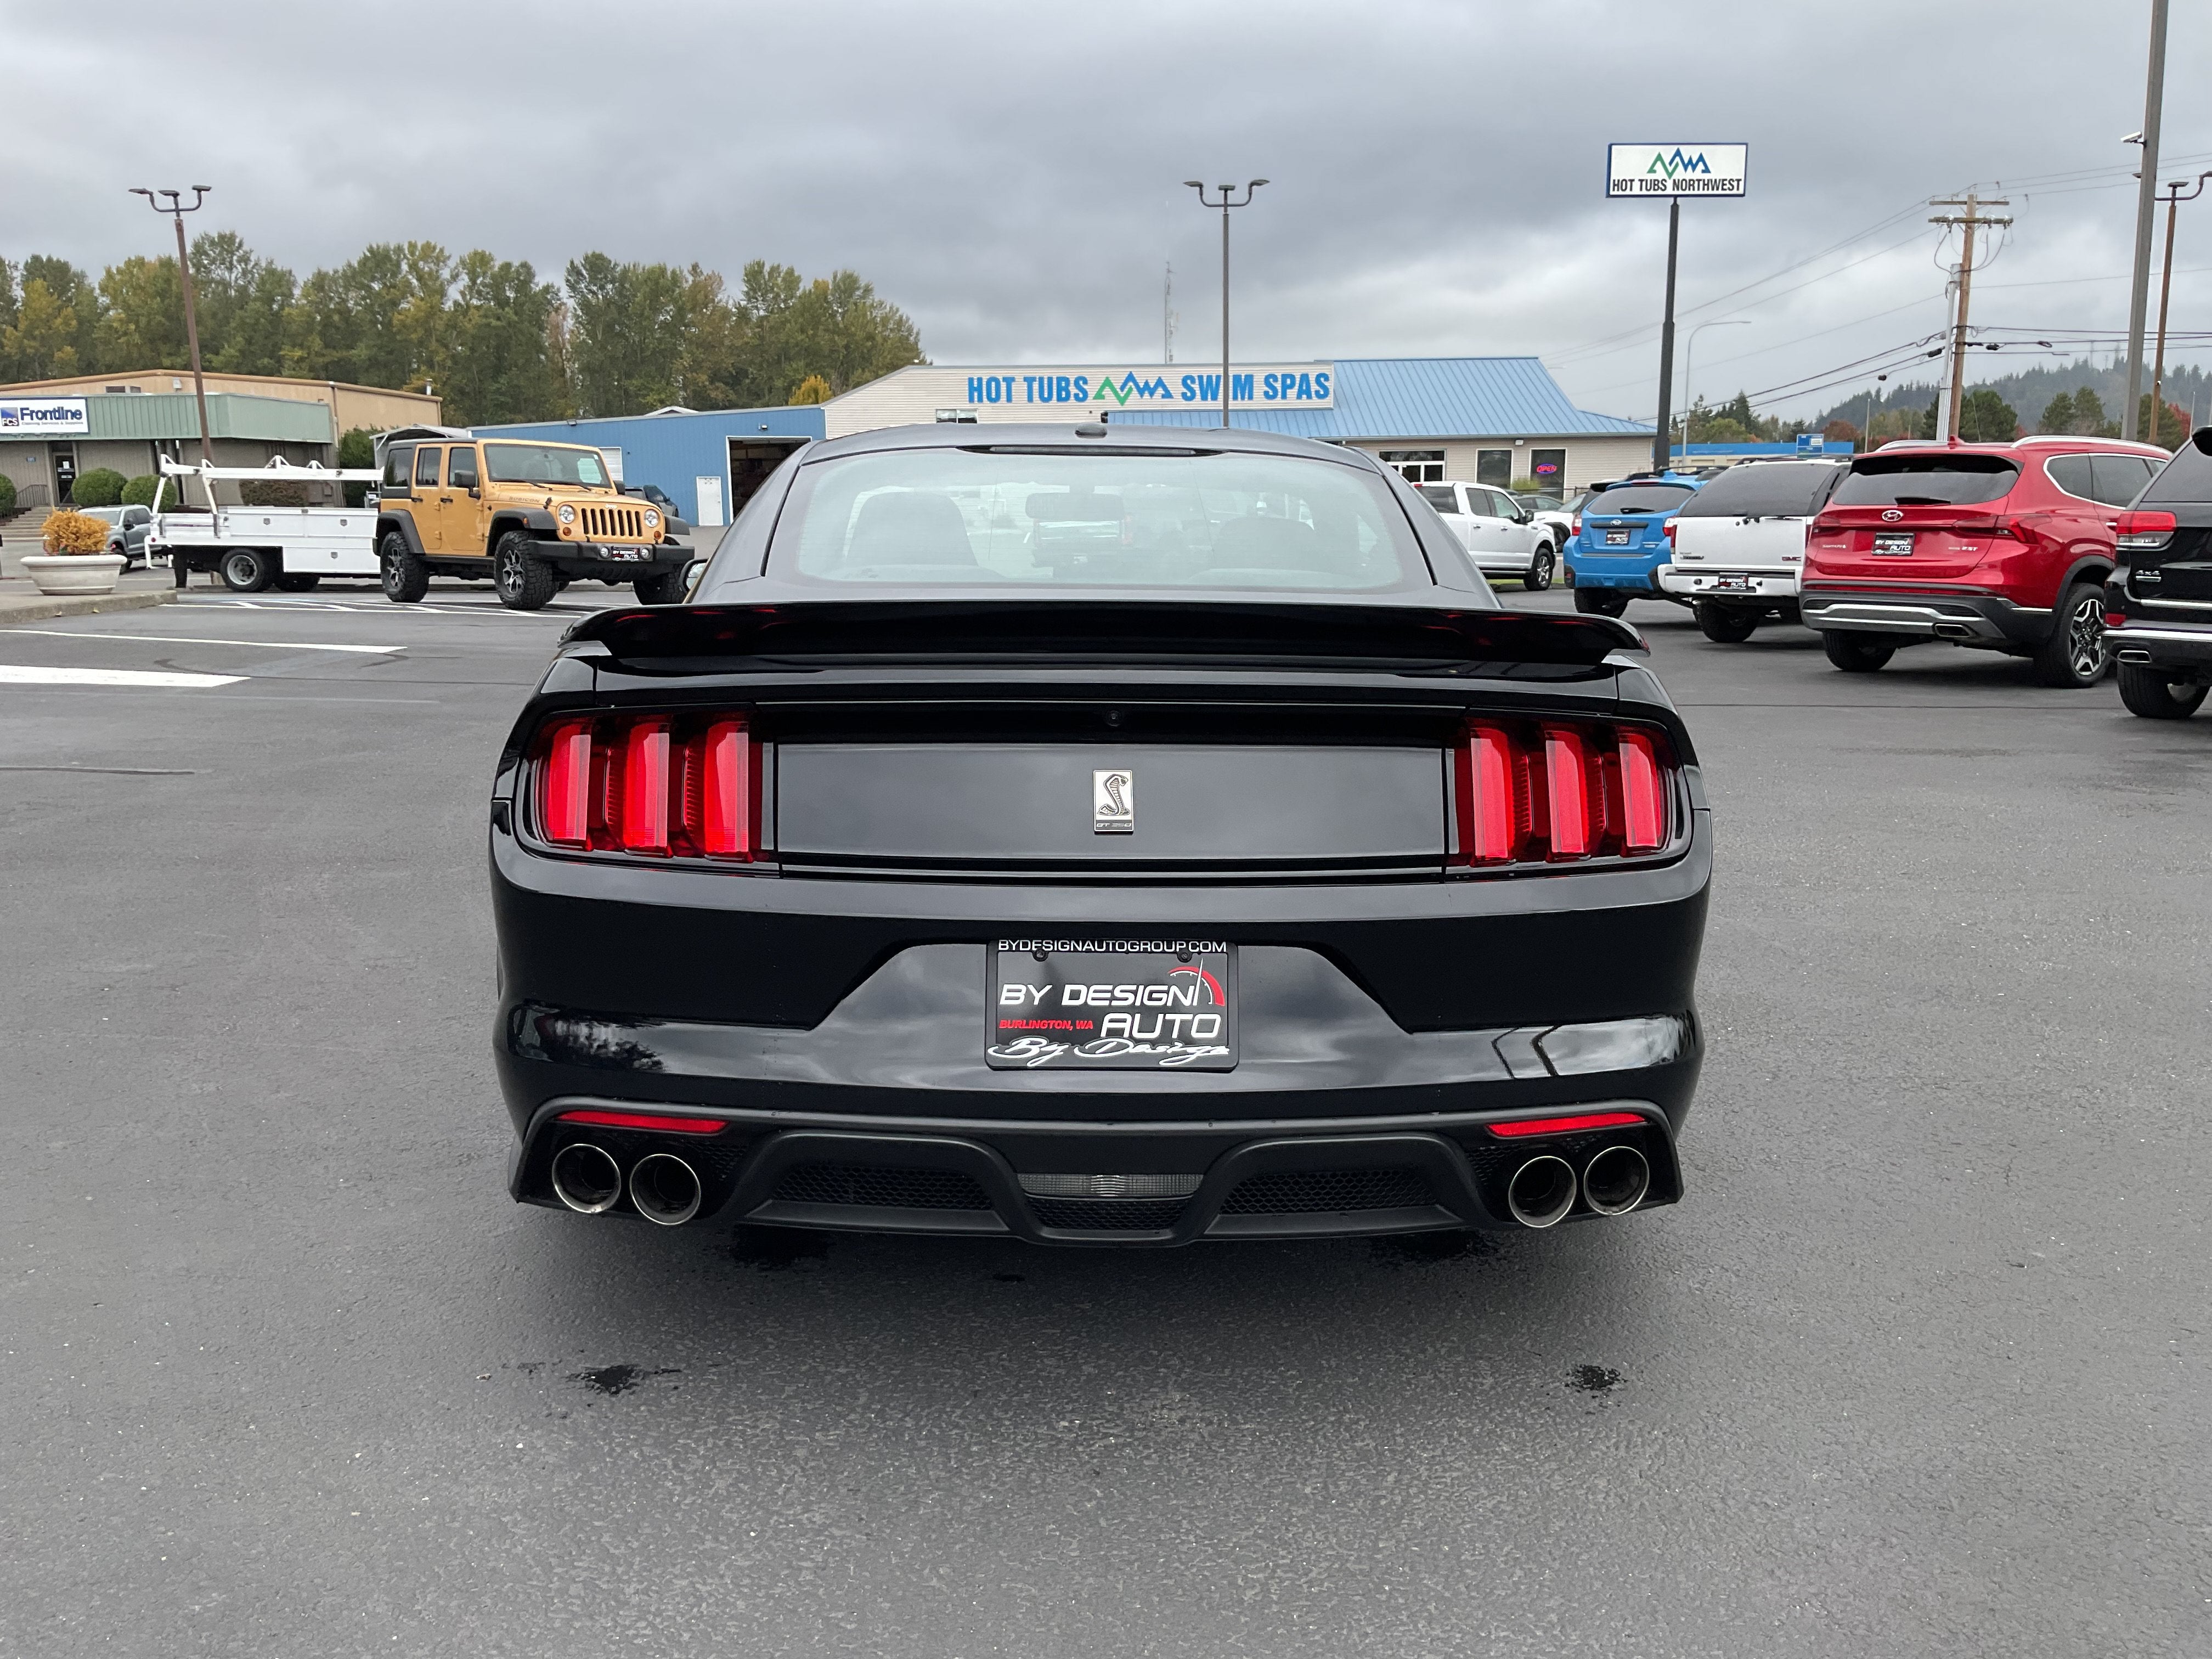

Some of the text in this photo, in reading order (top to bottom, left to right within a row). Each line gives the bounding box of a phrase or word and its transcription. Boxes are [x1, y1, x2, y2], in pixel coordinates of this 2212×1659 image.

[1612, 178, 1742, 192] HOT TUBS NORTHWEST
[968, 375, 1089, 404] HOT TUBS
[1181, 373, 1330, 402] SWM SPAS
[20, 407, 82, 421] Frontline
[999, 984, 1197, 1007] BY DESIGN
[998, 1019, 1094, 1031] BURLINGTON, WA
[1099, 1013, 1221, 1039] AUTO
[987, 1037, 1070, 1067] By
